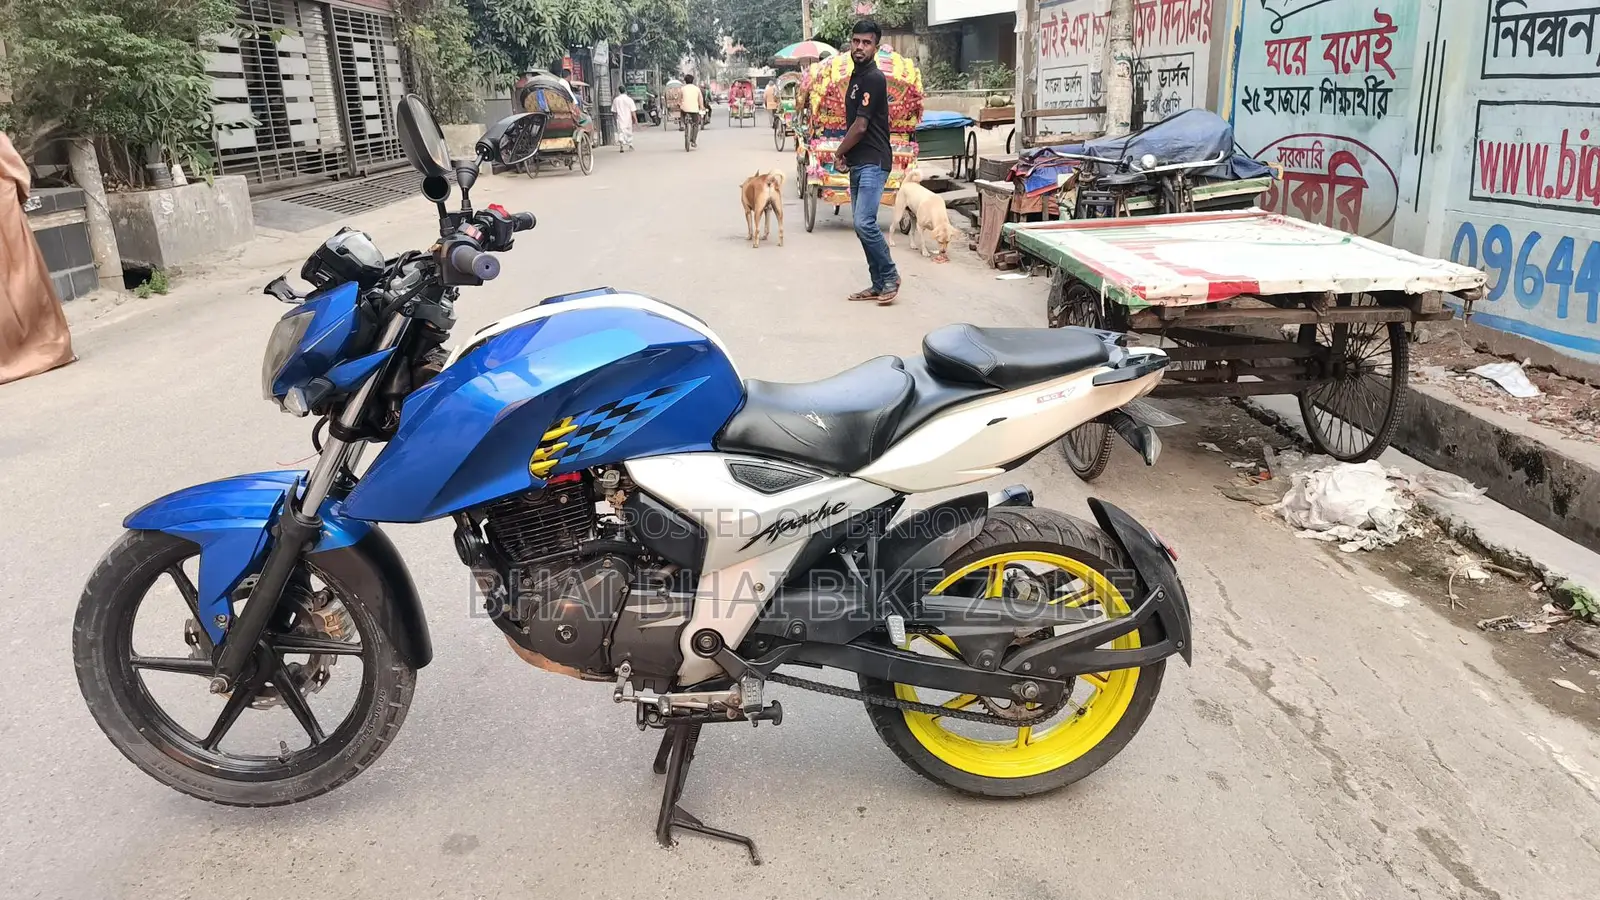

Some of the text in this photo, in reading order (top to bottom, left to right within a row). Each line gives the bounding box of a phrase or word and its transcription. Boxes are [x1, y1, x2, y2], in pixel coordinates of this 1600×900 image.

[1265, 7, 1398, 80] ঘরে বসেই
[862, 92, 870, 107] 3
[1242, 75, 1393, 119] ২৫ হাজার শিক্ষার্থীর
[1277, 140, 1325, 170] সরকারি
[1451, 221, 1600, 324] 09644
[737, 498, 849, 552] Apache
